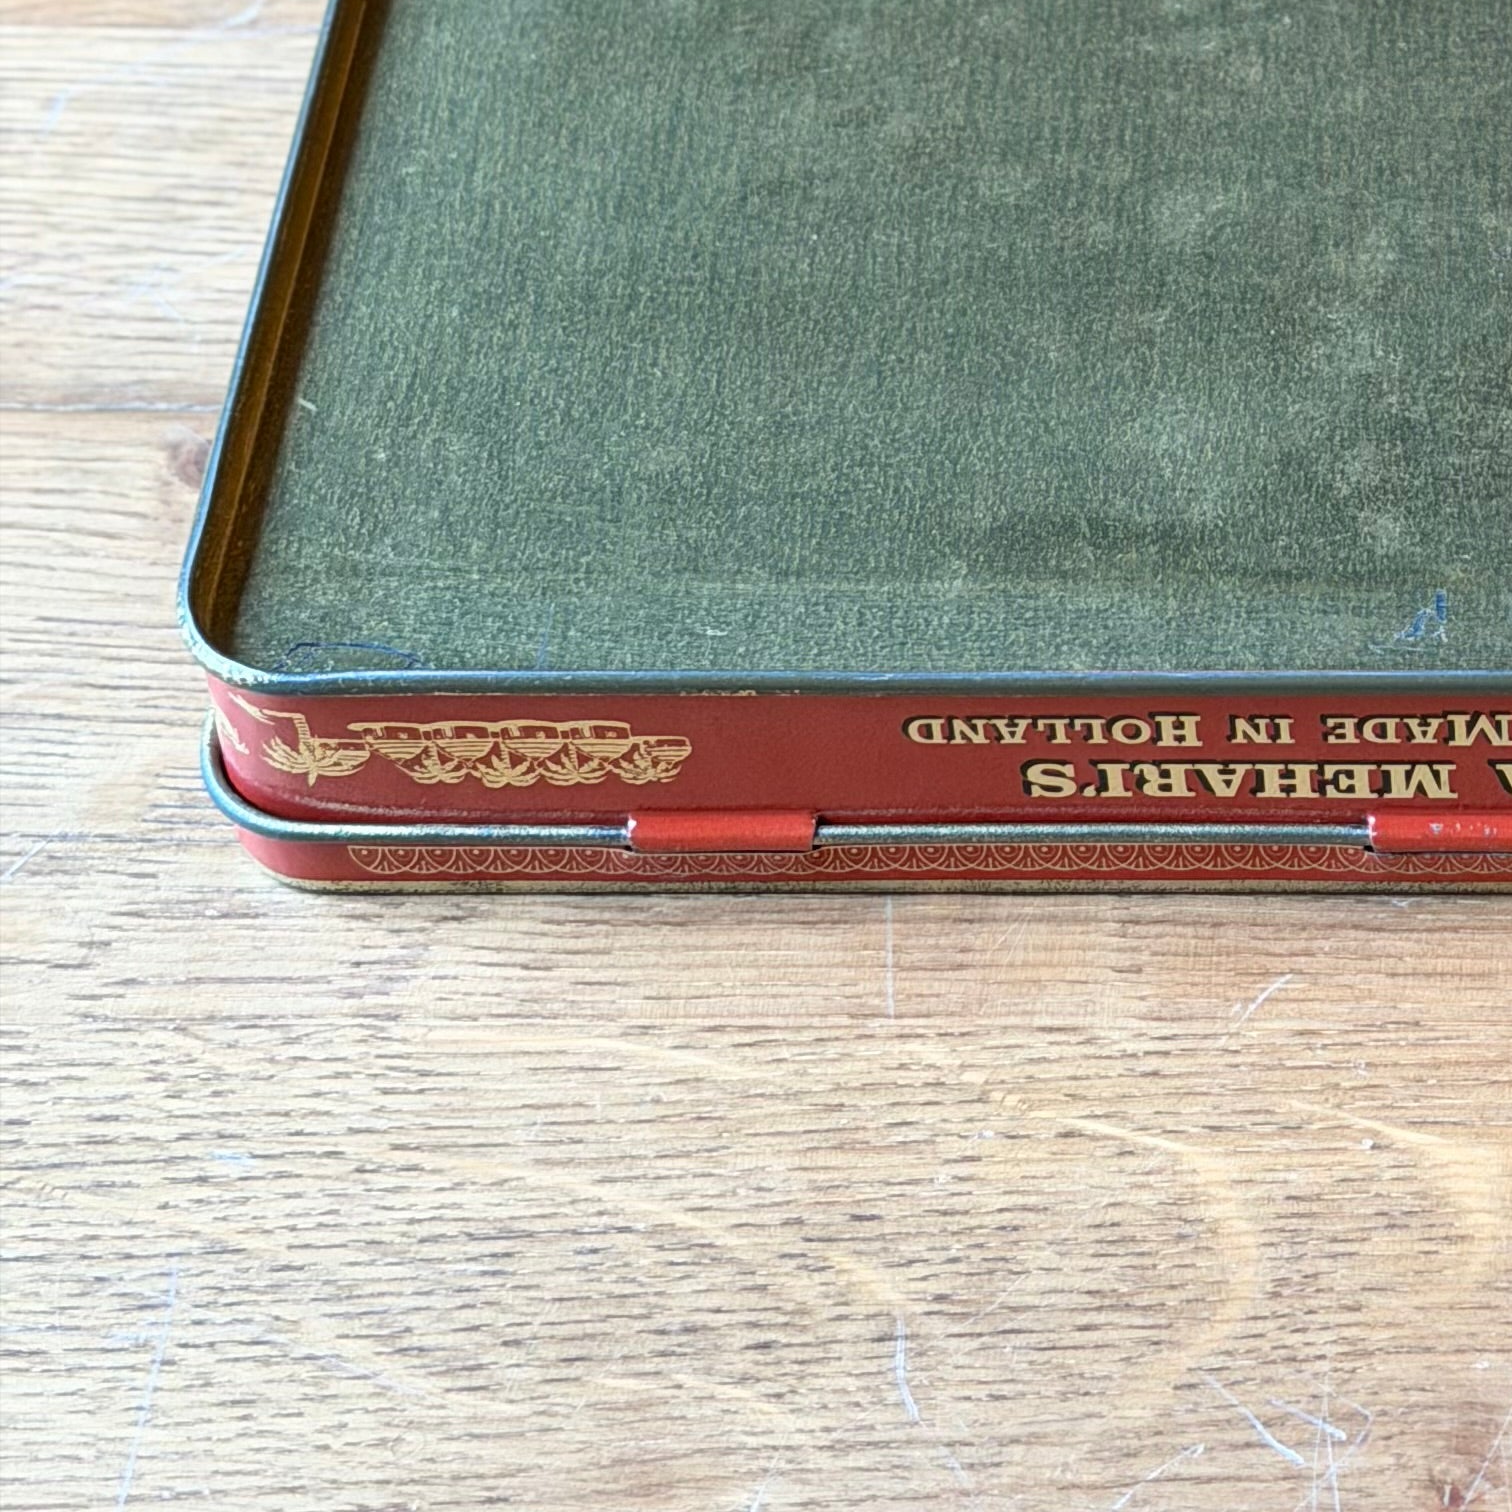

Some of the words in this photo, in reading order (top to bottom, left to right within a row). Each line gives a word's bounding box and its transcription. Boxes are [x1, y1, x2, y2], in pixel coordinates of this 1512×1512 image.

[905, 715, 1203, 747] HOLLAND
[1230, 717, 1296, 745] IN
[1025, 762, 1459, 799] MEHARI'S
